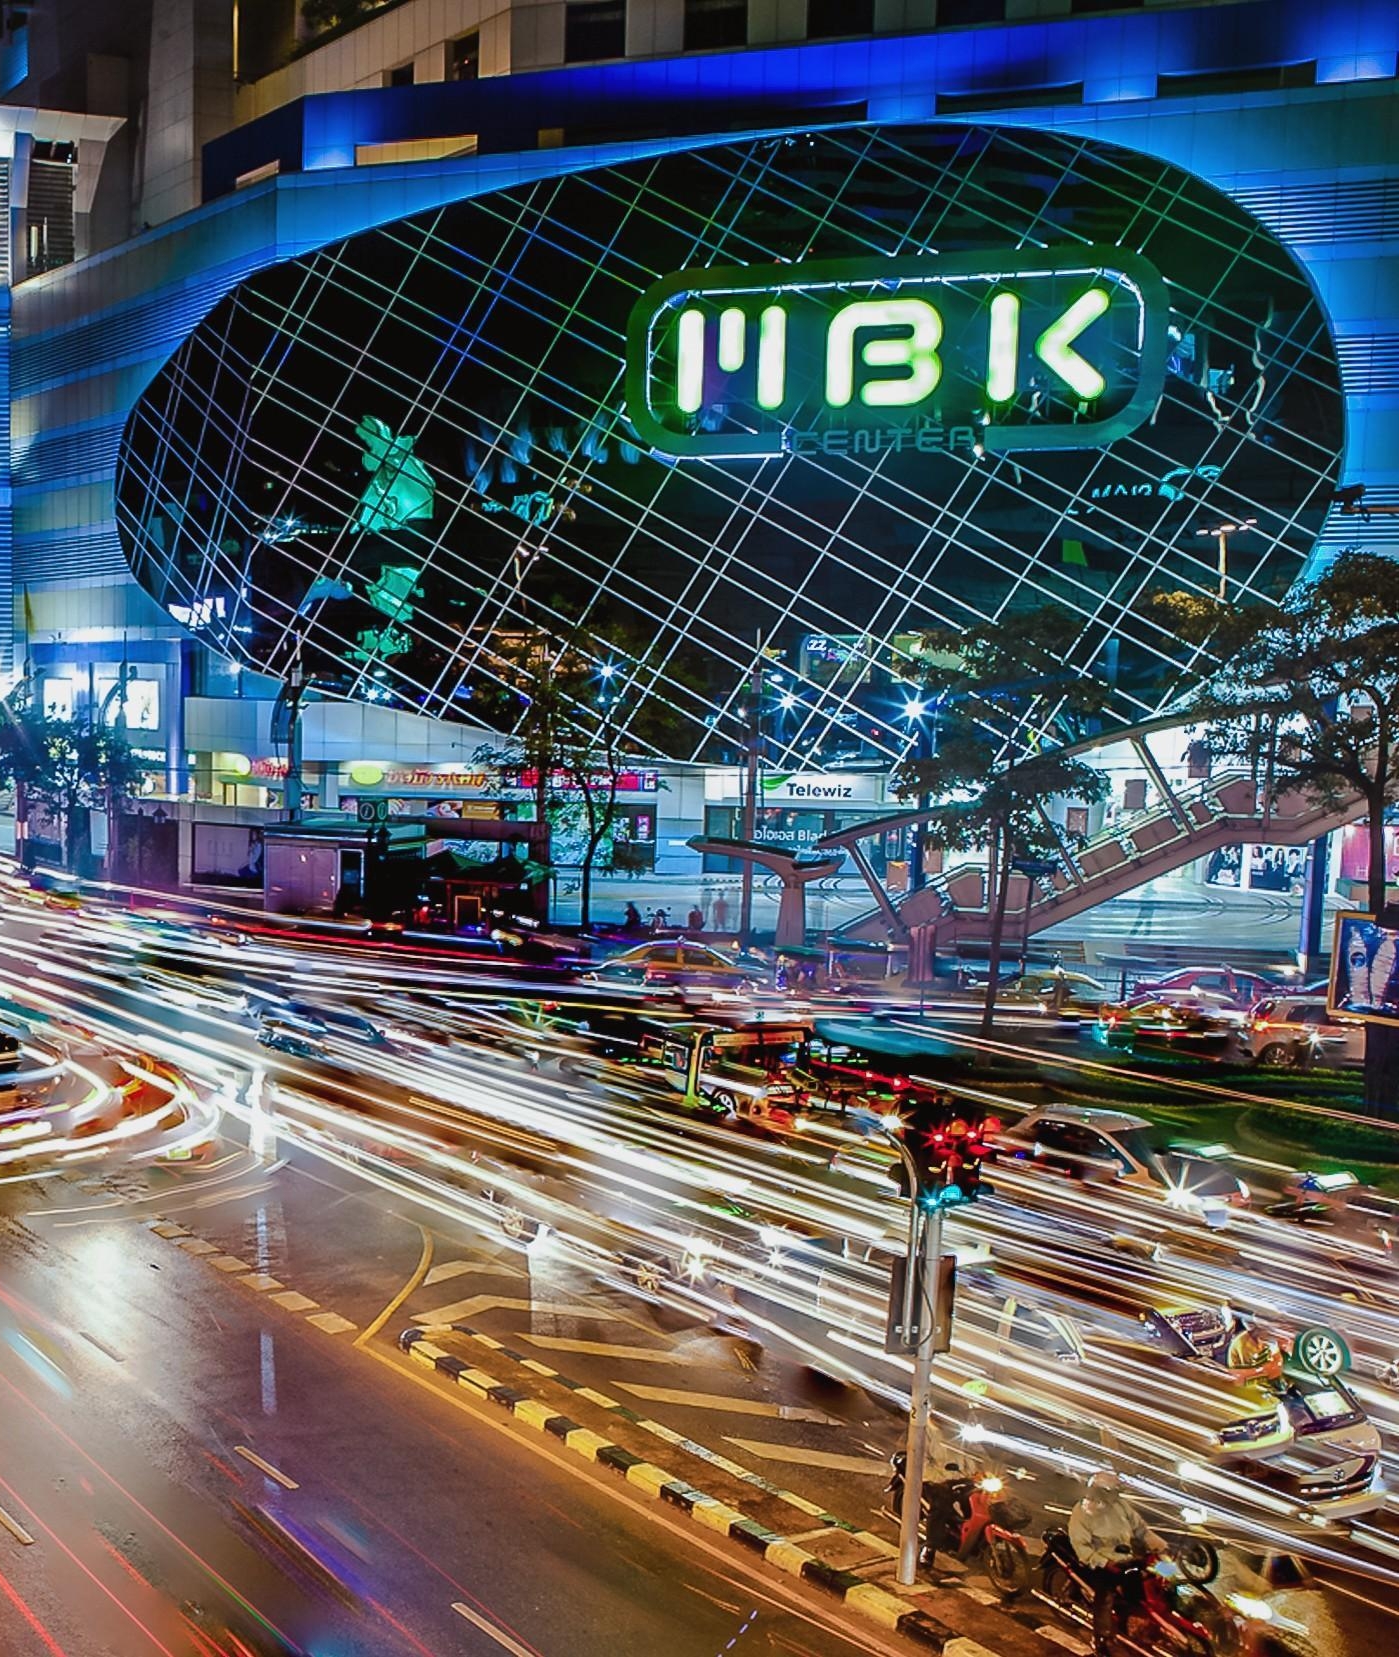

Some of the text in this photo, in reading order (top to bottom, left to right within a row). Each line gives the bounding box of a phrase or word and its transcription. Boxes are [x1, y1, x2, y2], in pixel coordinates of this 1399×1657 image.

[677, 289, 1109, 413] MBK
[793, 427, 975, 456] CENTER
[786, 782, 852, 798] Telewiz
